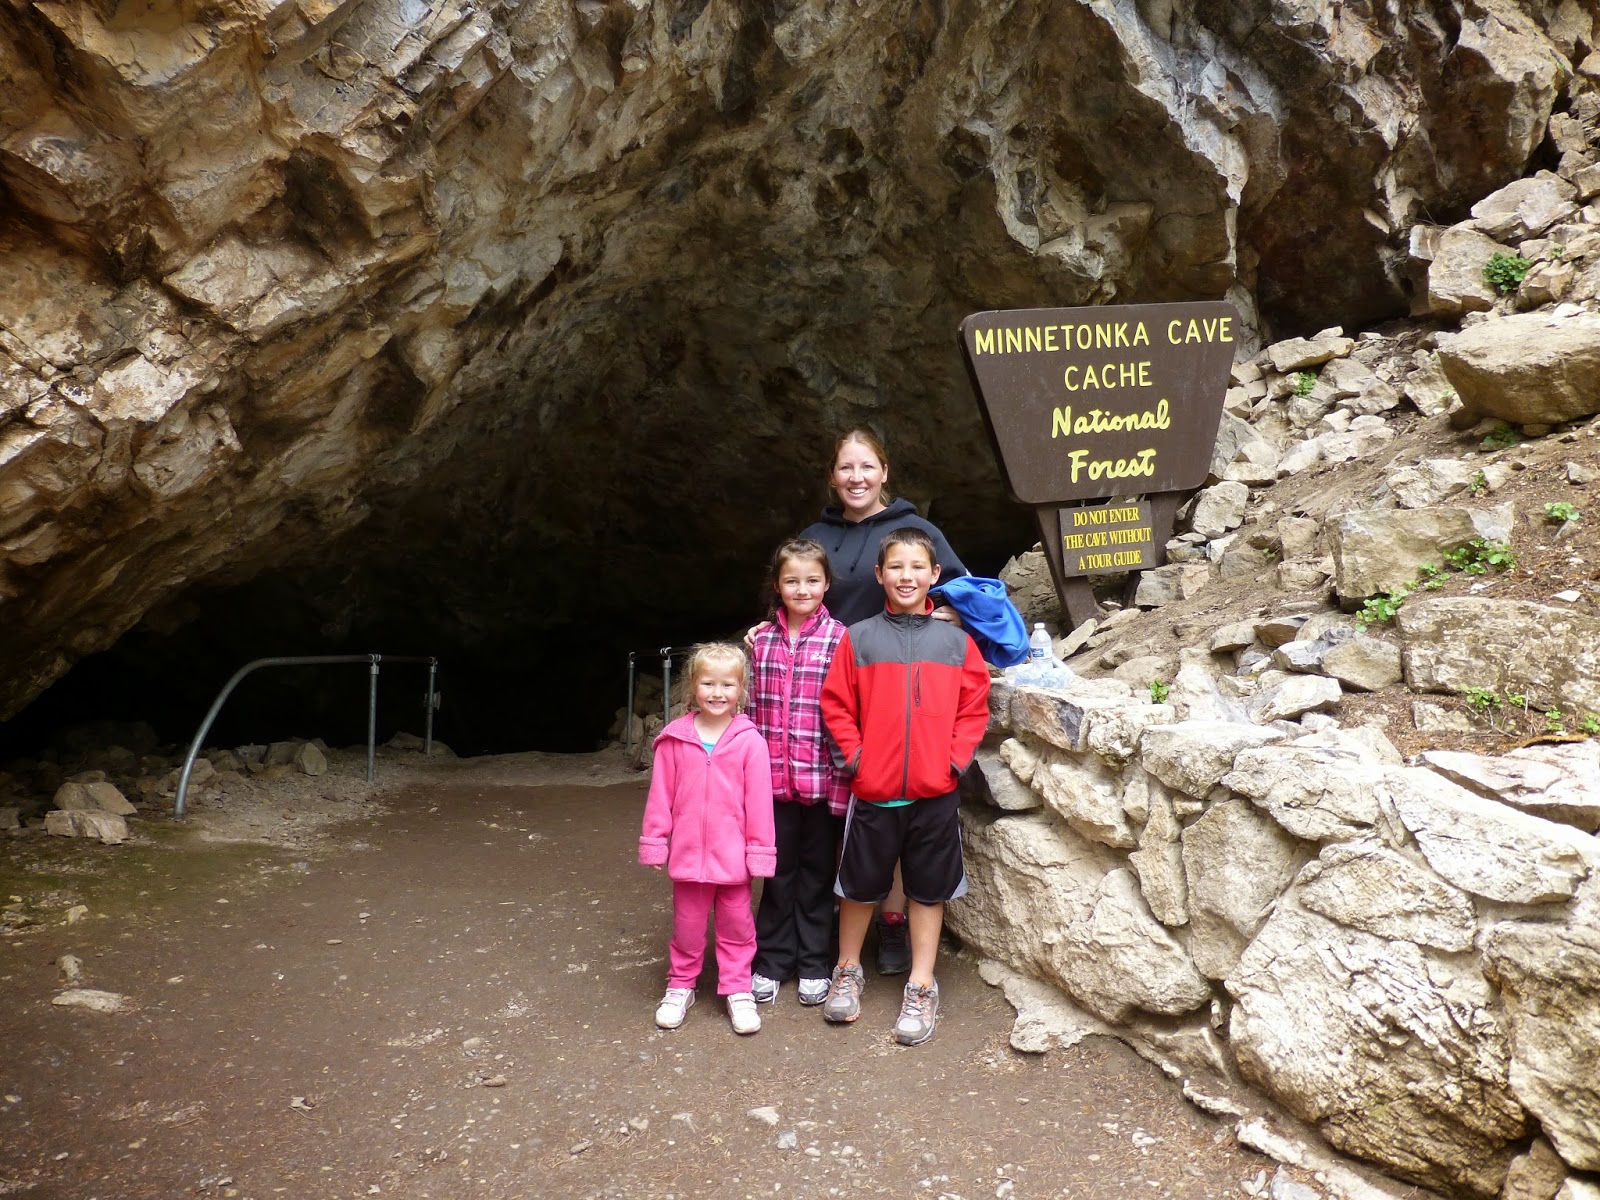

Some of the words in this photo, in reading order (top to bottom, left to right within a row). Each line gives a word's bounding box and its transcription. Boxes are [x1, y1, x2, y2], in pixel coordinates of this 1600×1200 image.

[975, 321, 1150, 355] MINNETONKA
[1167, 317, 1233, 345] CAVE
[1064, 361, 1152, 391] CACHE
[1051, 398, 1170, 438] National
[1067, 448, 1156, 484] Forest
[1073, 512, 1088, 526] DO
[1089, 510, 1107, 525] NOT
[1109, 507, 1140, 523] ENTER
[1064, 534, 1084, 549] THE
[1086, 532, 1107, 547] CAVE
[1109, 527, 1151, 545] WITHOUT
[1078, 556, 1086, 570] A
[1087, 553, 1112, 569] TOUR
[1113, 550, 1142, 566] GUIDE
